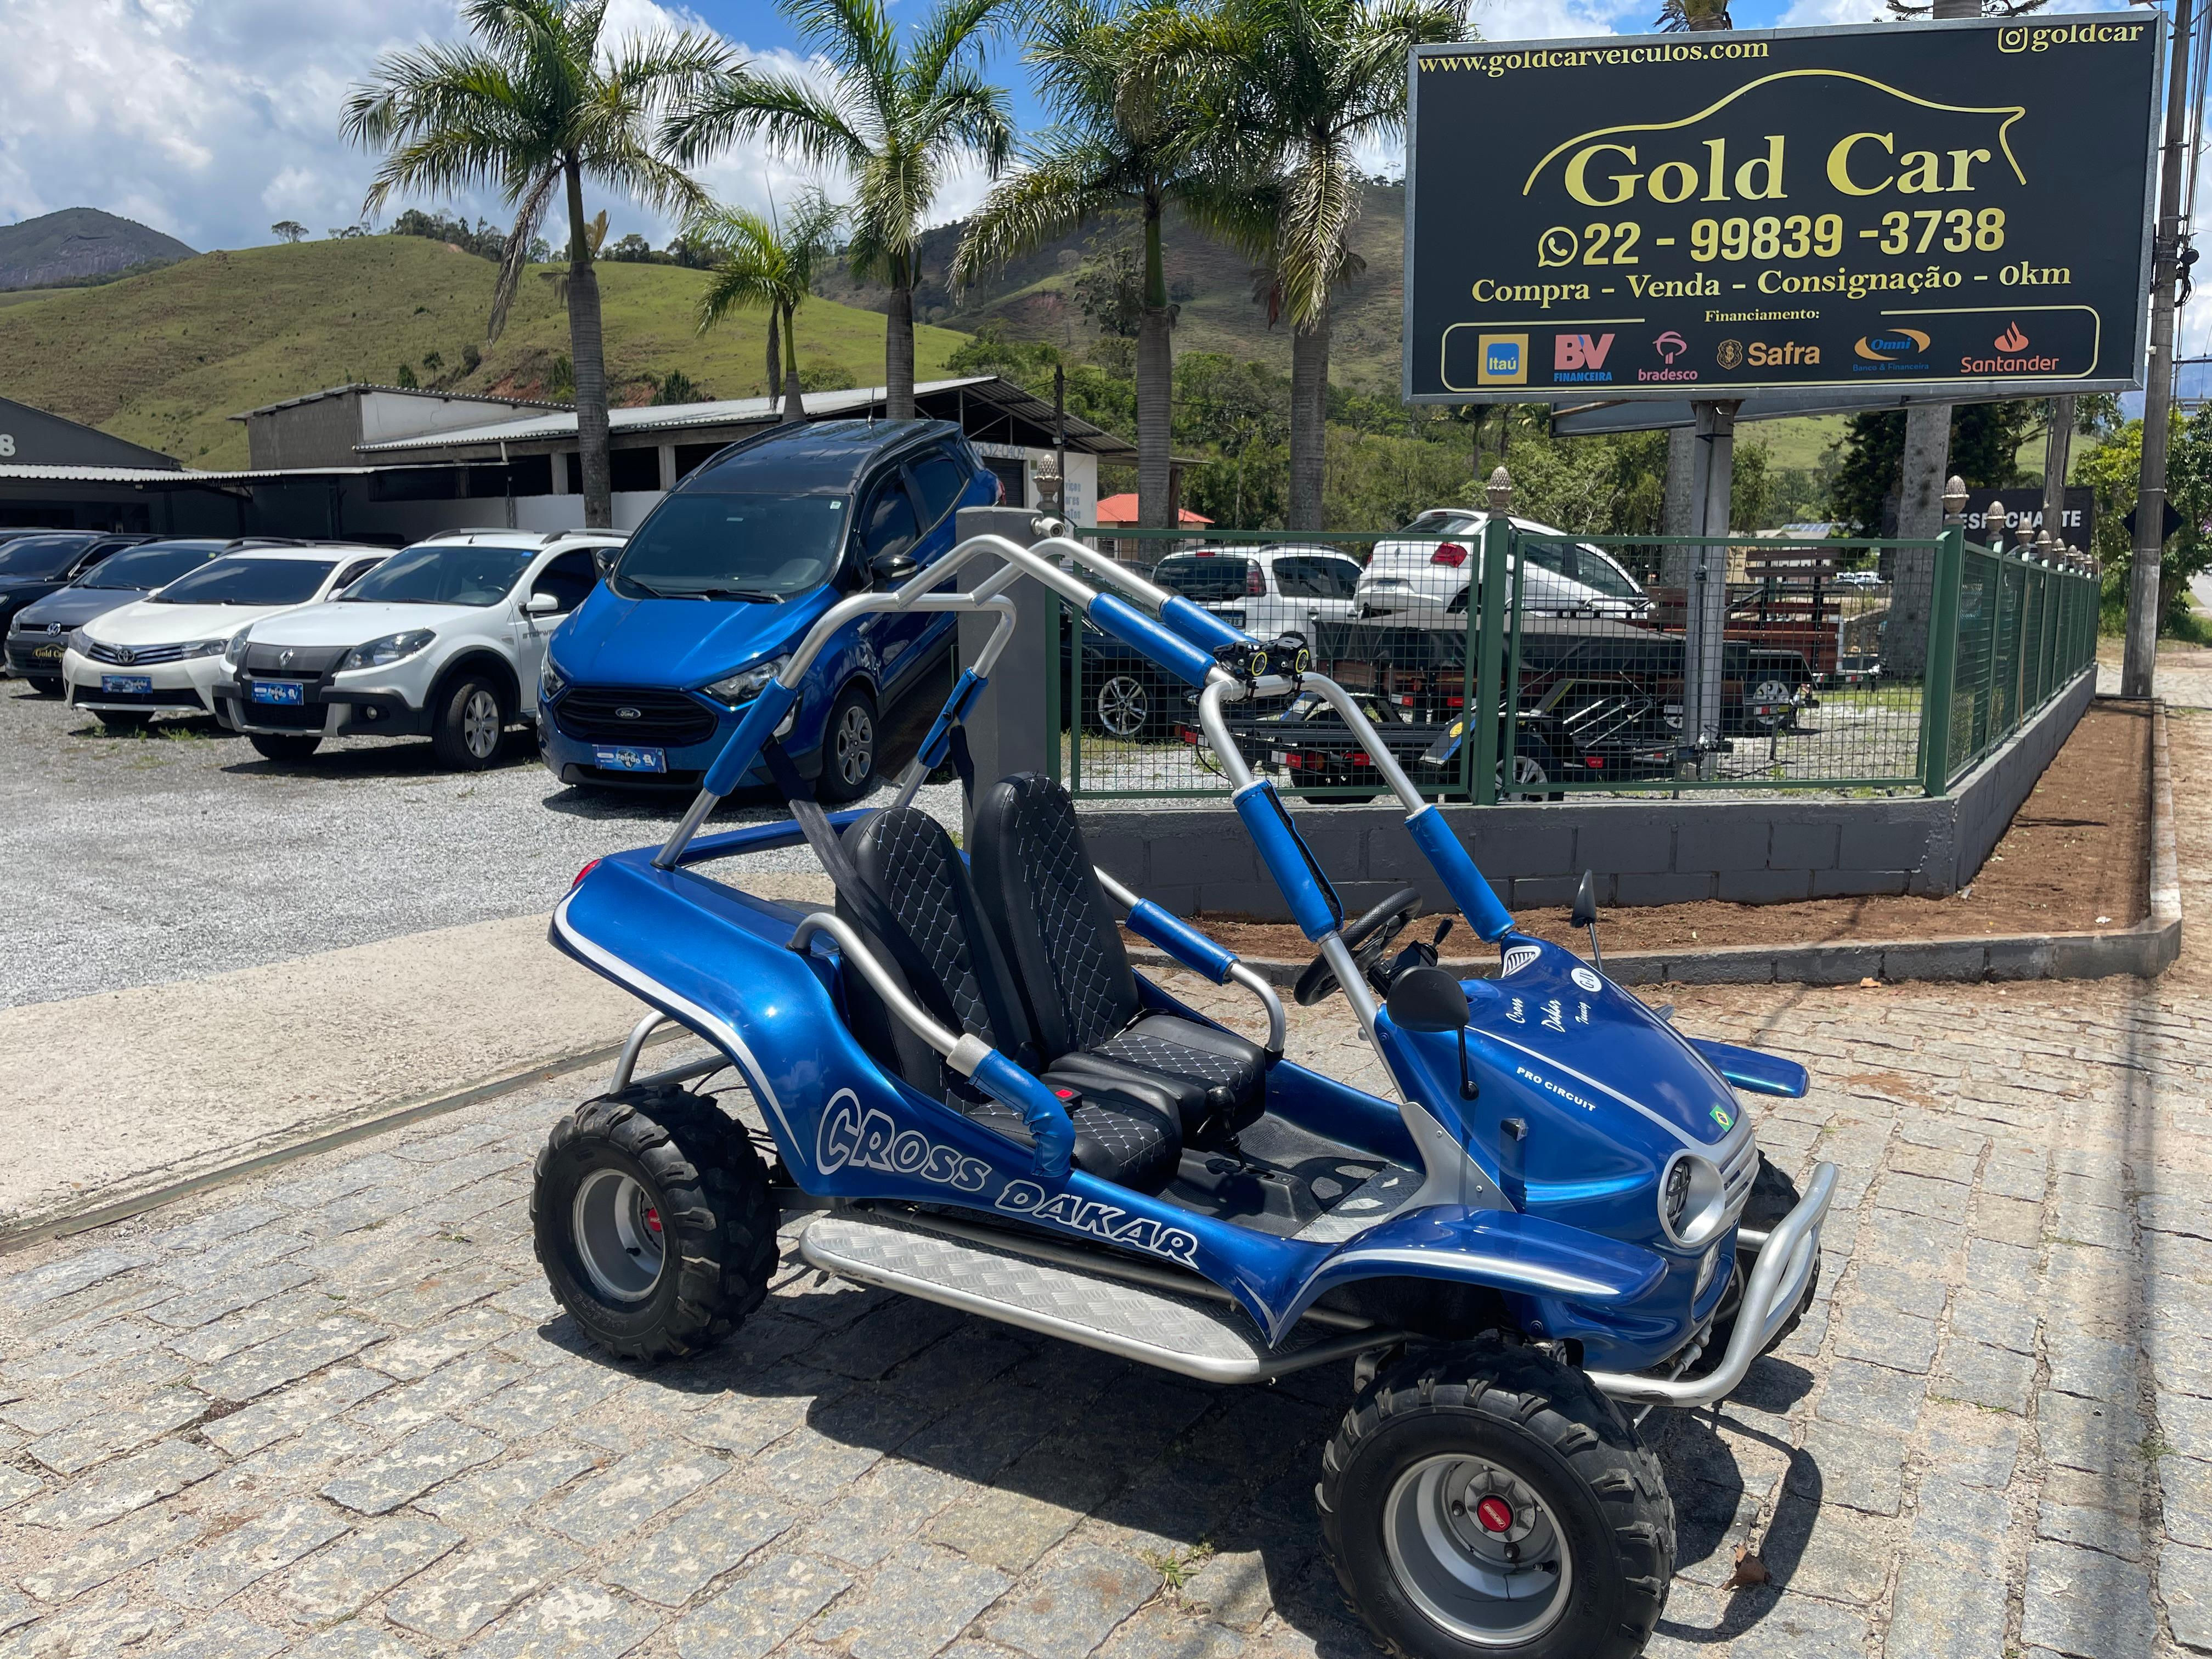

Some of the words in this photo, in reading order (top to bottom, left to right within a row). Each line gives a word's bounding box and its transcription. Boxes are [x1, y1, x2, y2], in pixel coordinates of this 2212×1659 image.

[2032, 24, 2143, 53] goldcar
[1418, 42, 1769, 77] www.goldcarveiculos.com
[1565, 135, 1788, 207] Gold
[1827, 132, 1991, 196] Car
[1583, 222, 1641, 266] 22
[1690, 213, 1843, 262] 99839
[1471, 279, 1590, 309] Compra
[1626, 273, 1721, 298] Venda
[1757, 266, 1962, 300] Consignação
[1704, 308, 1820, 323] Financiamento:
[1554, 334, 1616, 370] BV
[1747, 341, 1820, 366] Safra
[1871, 337, 1912, 351] Omni
[1488, 357, 1517, 371] Itaú
[1554, 371, 1613, 382] FINANCEIRA
[1638, 368, 1698, 381] bradesco
[1852, 364, 1877, 372] Banco
[1888, 362, 1929, 371] Financeira
[1960, 355, 2059, 374] Santander
[1505, 997, 1525, 1023] Cross
[1541, 998, 1566, 1033] Dakar
[1516, 1066, 1542, 1084] PRO
[1544, 1081, 1596, 1112] CIRCUIT
[816, 1087, 992, 1193] CROSS
[995, 1179, 1201, 1270] DAKAR
